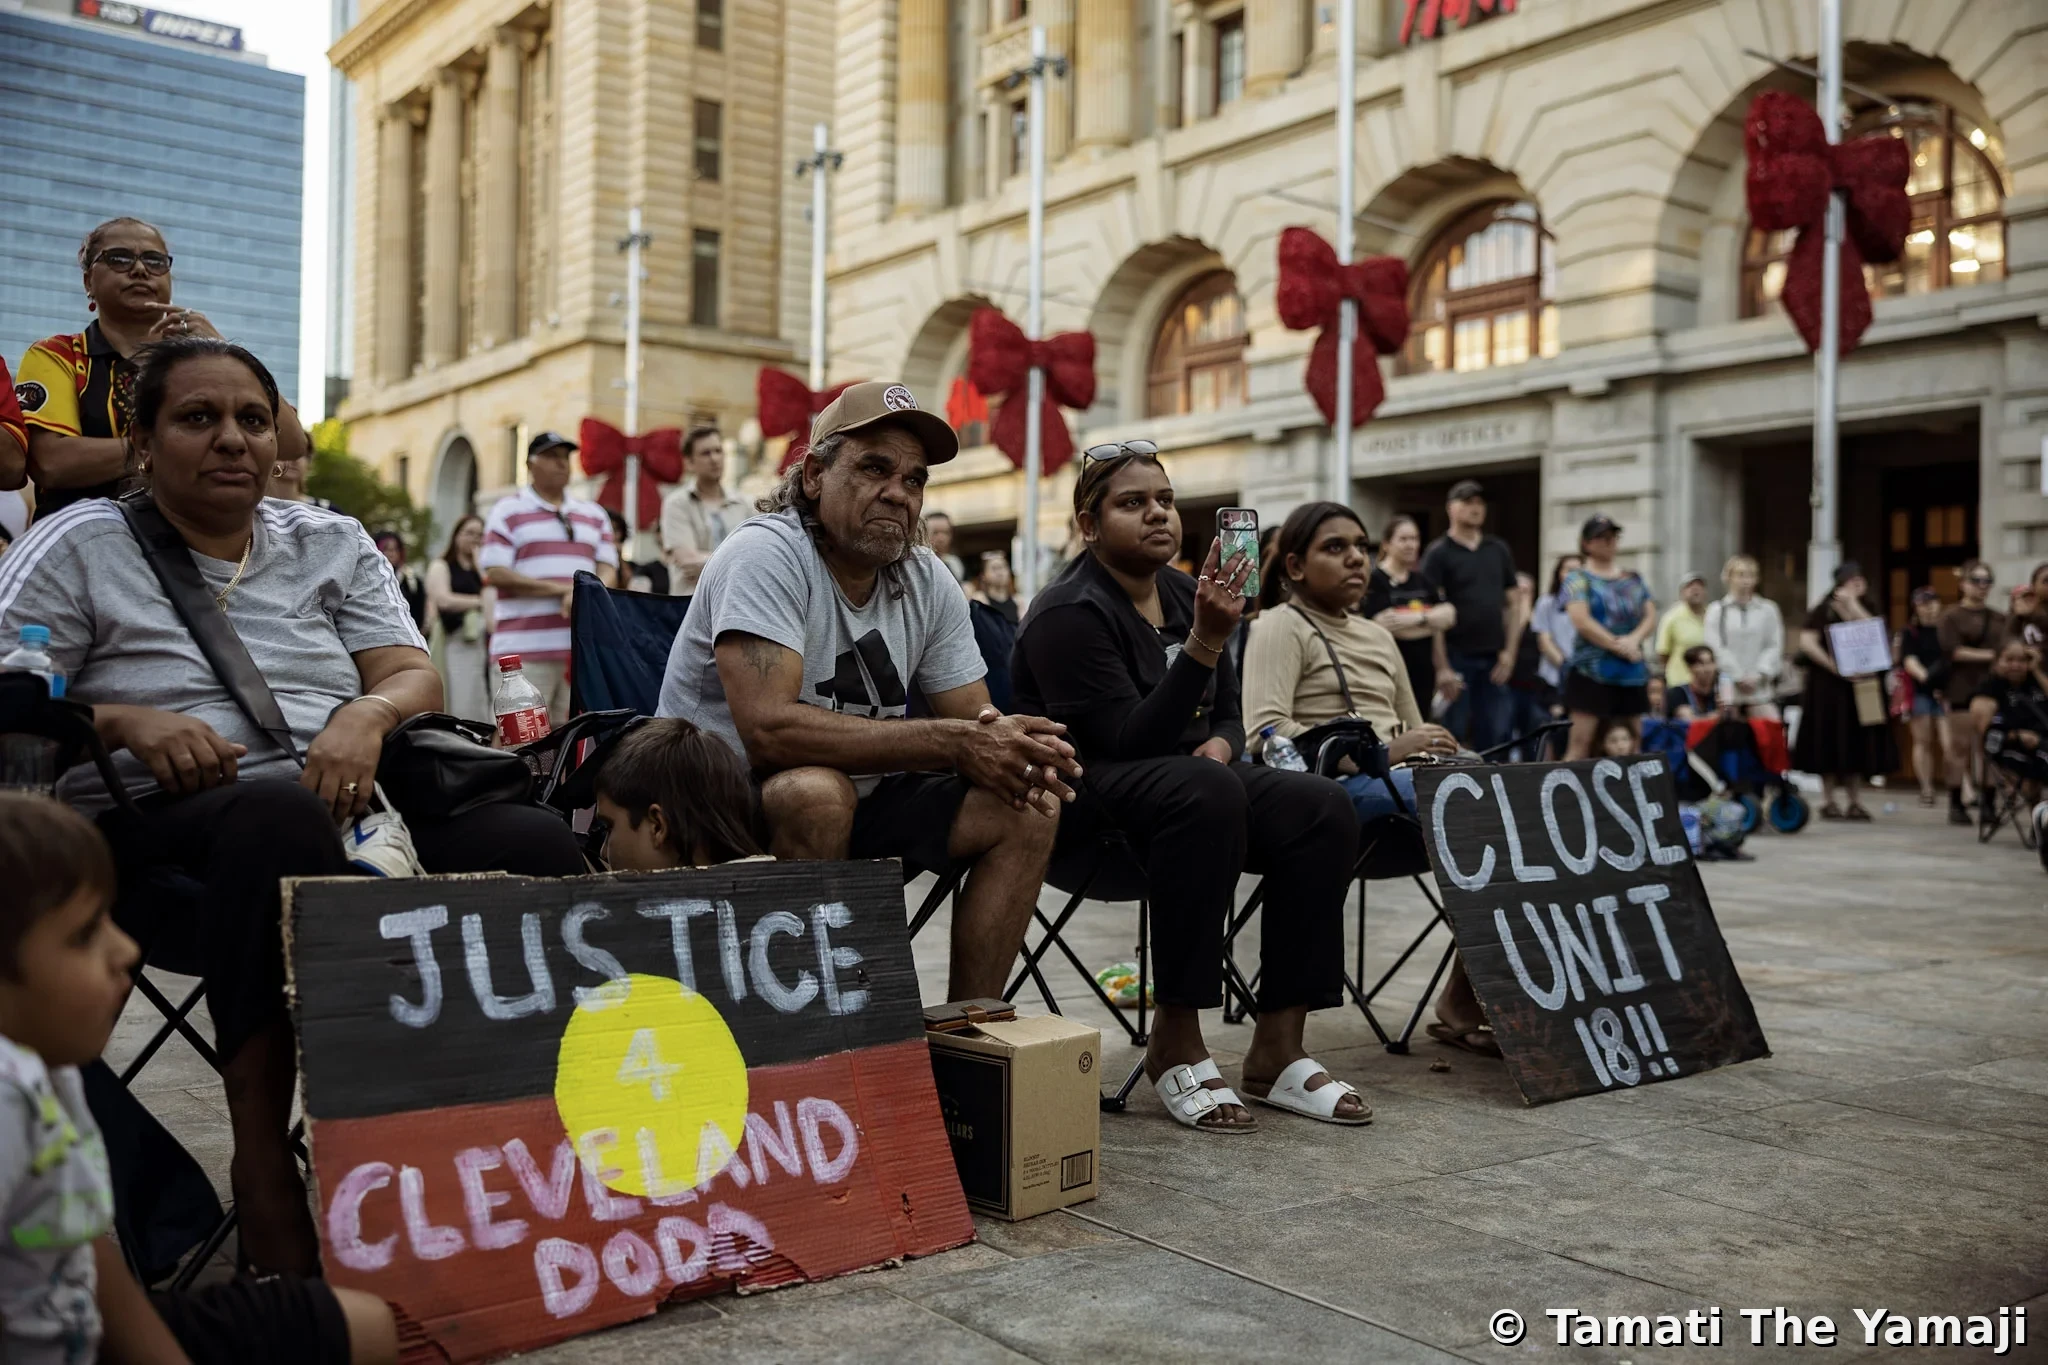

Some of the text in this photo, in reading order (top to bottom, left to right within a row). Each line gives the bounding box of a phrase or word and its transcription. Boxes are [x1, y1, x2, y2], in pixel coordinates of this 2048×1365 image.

[149, 13, 235, 47] INPEX
[1432, 759, 1687, 892] CLOSE
[379, 900, 870, 1028] JUSTICE
[1494, 884, 1683, 1010] UNIT
[615, 1027, 686, 1101] 4
[1574, 1003, 1680, 1087] 18!!
[328, 1096, 859, 1272] CLEVELAND
[534, 1202, 776, 1318] DODD
